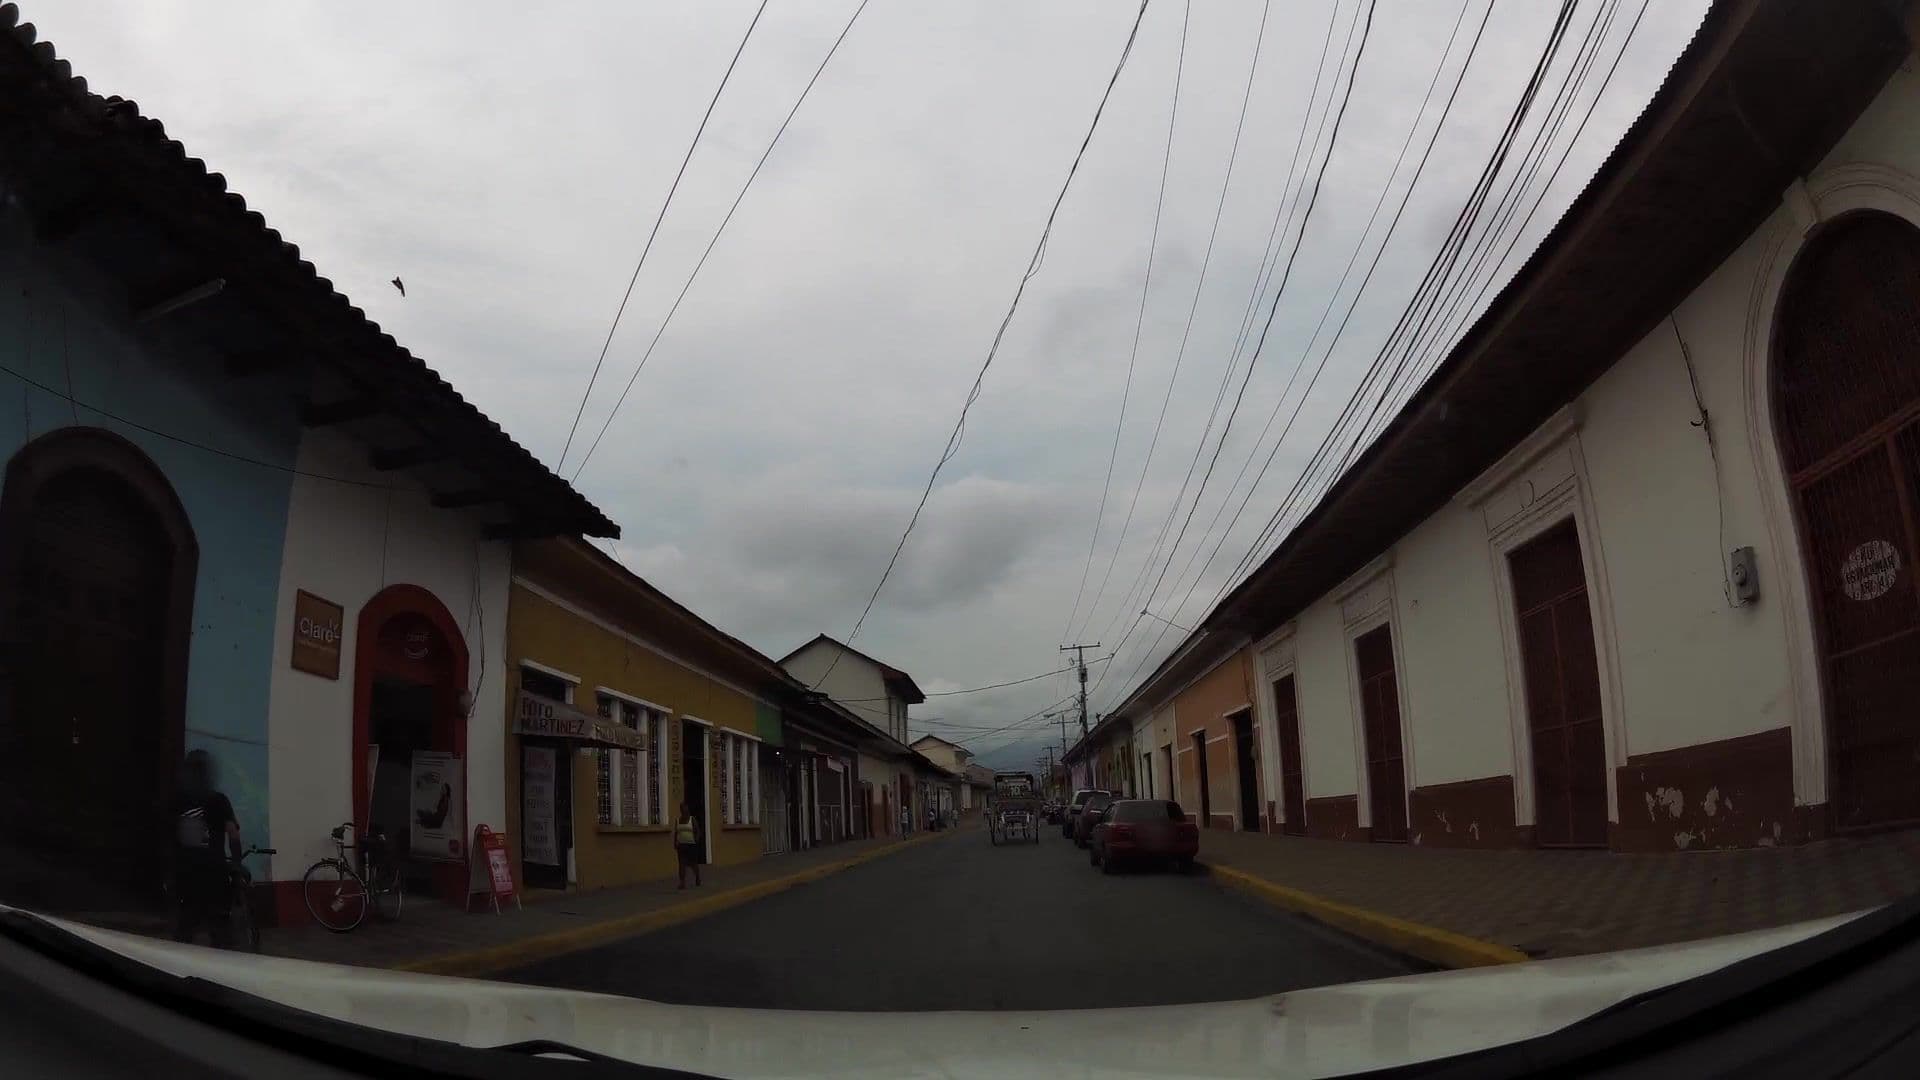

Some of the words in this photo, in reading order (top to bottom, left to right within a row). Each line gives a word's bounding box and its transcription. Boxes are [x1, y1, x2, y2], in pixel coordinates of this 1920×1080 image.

[299, 616, 335, 642] Claro
[521, 697, 552, 719] FOTO
[520, 718, 586, 737] MARTINEZ
